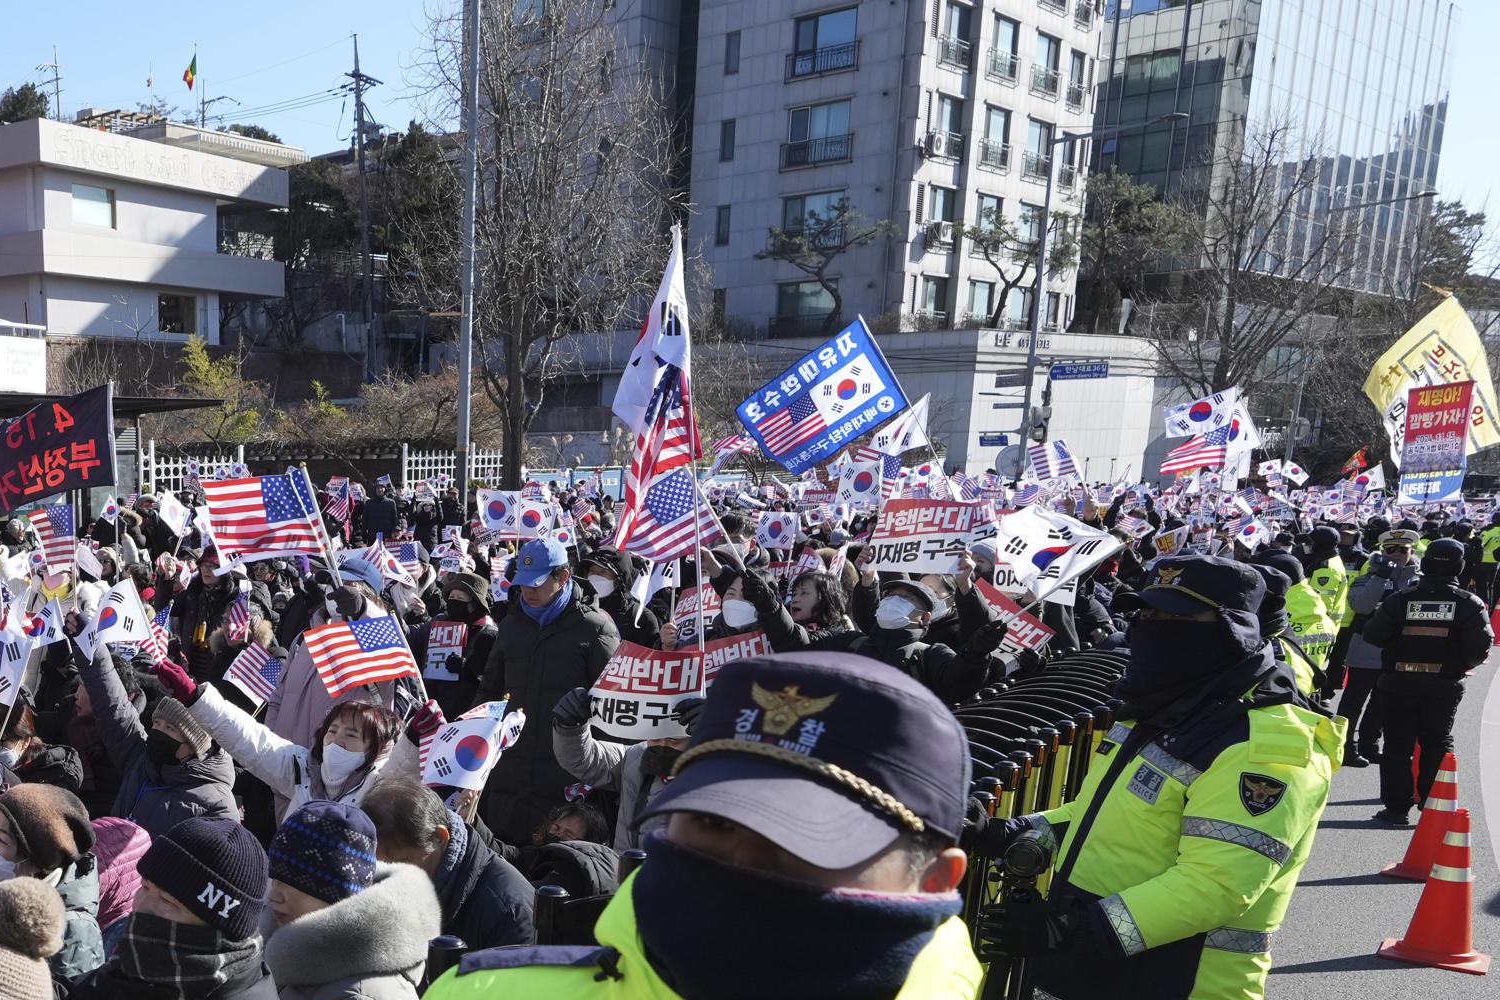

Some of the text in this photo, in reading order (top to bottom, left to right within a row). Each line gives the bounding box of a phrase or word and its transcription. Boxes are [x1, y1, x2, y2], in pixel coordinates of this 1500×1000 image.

[1418, 388, 1462, 406] 재명아!
[874, 505, 971, 538] 탄핵반대
[868, 538, 968, 564] 이재명 구속
[593, 698, 639, 726] 재명
[734, 708, 759, 734] 경
[1130, 781, 1154, 800] POLICE
[197, 882, 240, 918] NY
